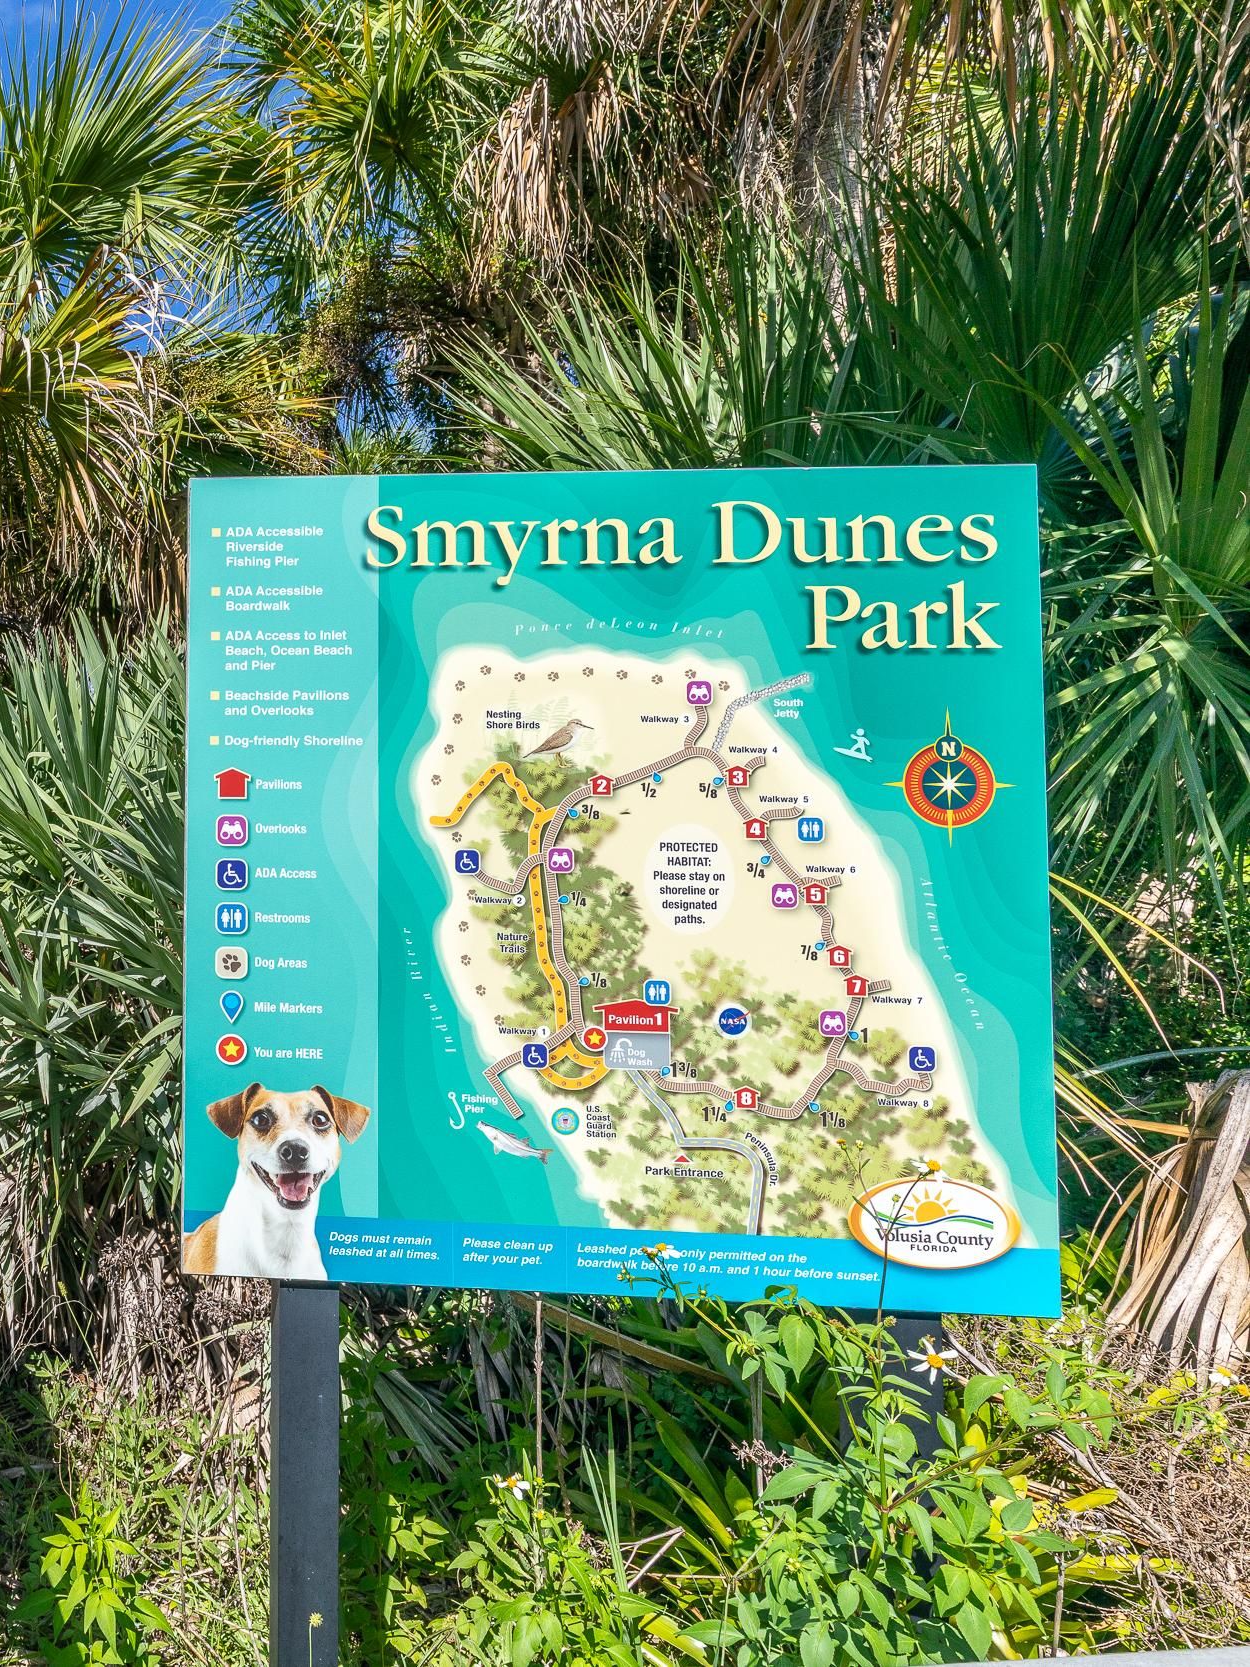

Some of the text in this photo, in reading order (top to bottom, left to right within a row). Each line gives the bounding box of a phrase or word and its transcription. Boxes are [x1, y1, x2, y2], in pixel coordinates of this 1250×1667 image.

[226, 526, 323, 537] ADA Accessible
[226, 542, 284, 552] Riverside
[366, 500, 999, 585] Smyrna Dunes
[226, 556, 299, 568] Fishing Pier
[226, 586, 323, 597] ADA Accessible
[226, 601, 290, 611] Boardwalk
[805, 580, 1003, 650] Park
[515, 620, 573, 636] Ponce
[671, 621, 725, 639] Inlet
[225, 630, 347, 641] ADA Access to Inlet
[225, 645, 353, 657] Beach, Ocean Beach
[225, 661, 276, 671] and Pier
[225, 690, 350, 701] Beachside Pavilions
[774, 698, 804, 707] South
[225, 705, 314, 716] and Overlooks
[486, 710, 522, 721] Nesting
[774, 709, 800, 719] Jetty
[486, 720, 540, 729] Shore Birds
[640, 715, 690, 724] Walkway 3
[225, 735, 363, 748] Dog-friendly Shoreline
[728, 746, 778, 755] Walkway 4
[941, 741, 956, 757] N
[732, 770, 744, 784] 3
[256, 779, 302, 790] Pavilions
[596, 779, 607, 793] 2
[759, 795, 809, 804] Walkway 5
[255, 823, 307, 835] Overlooks
[749, 822, 761, 836] 4
[659, 842, 718, 853] PROTECTED
[667, 857, 712, 867] HABITAT:
[254, 868, 317, 879] ADA Access
[805, 865, 856, 874] Walkway 6
[653, 871, 725, 884] Please stay on
[659, 886, 719, 896] shoreline or
[810, 888, 821, 902] 5
[474, 896, 523, 905] Walkway 2
[662, 900, 717, 912] designated
[254, 912, 311, 924] Restrooms
[674, 914, 706, 925] paths.
[497, 932, 528, 942] Nature
[403, 927, 423, 980] River
[499, 945, 526, 954] Trails
[834, 950, 845, 964] 6
[254, 958, 308, 970] Dog Areas
[852, 979, 862, 993] 7
[871, 996, 923, 1005] Walkway 7
[954, 973, 984, 1030] Ocean
[254, 1002, 323, 1014] Mile Markers
[608, 1013, 662, 1026] Pavilion 1
[499, 1027, 537, 1037] Walkway
[860, 1028, 868, 1043] 1
[254, 1047, 323, 1060] You are HERE
[627, 1048, 646, 1059] Dog
[627, 1057, 653, 1067] Wash
[462, 1094, 498, 1106] Fishing
[740, 1092, 752, 1105] 8
[877, 1099, 929, 1108] Walkway 8
[465, 1104, 485, 1114] Pier
[586, 1105, 603, 1113] U.S.
[586, 1122, 612, 1130] Guard
[586, 1130, 617, 1138] Station
[745, 1132, 778, 1187] Peninsula Dr.
[645, 1166, 724, 1178] Park Entrance
[329, 1231, 432, 1246] Dogs must remain
[875, 1228, 994, 1251] Volusia County
[463, 1237, 553, 1253] Please clean up
[910, 1244, 958, 1253] FLORIDA
[329, 1245, 440, 1260] leashed at all times.
[577, 1243, 627, 1255] Leashed
[681, 1249, 706, 1261] only
[708, 1251, 766, 1262] permitted
[769, 1254, 785, 1263] on
[788, 1254, 807, 1264] the
[463, 1252, 542, 1266] after your pet.
[683, 1263, 696, 1273] 10
[698, 1265, 723, 1274] a.m.
[727, 1265, 750, 1275] and
[753, 1266, 759, 1276] 1
[763, 1266, 791, 1278] hour
[794, 1268, 833, 1279] before
[836, 1272, 880, 1282] sunset.
